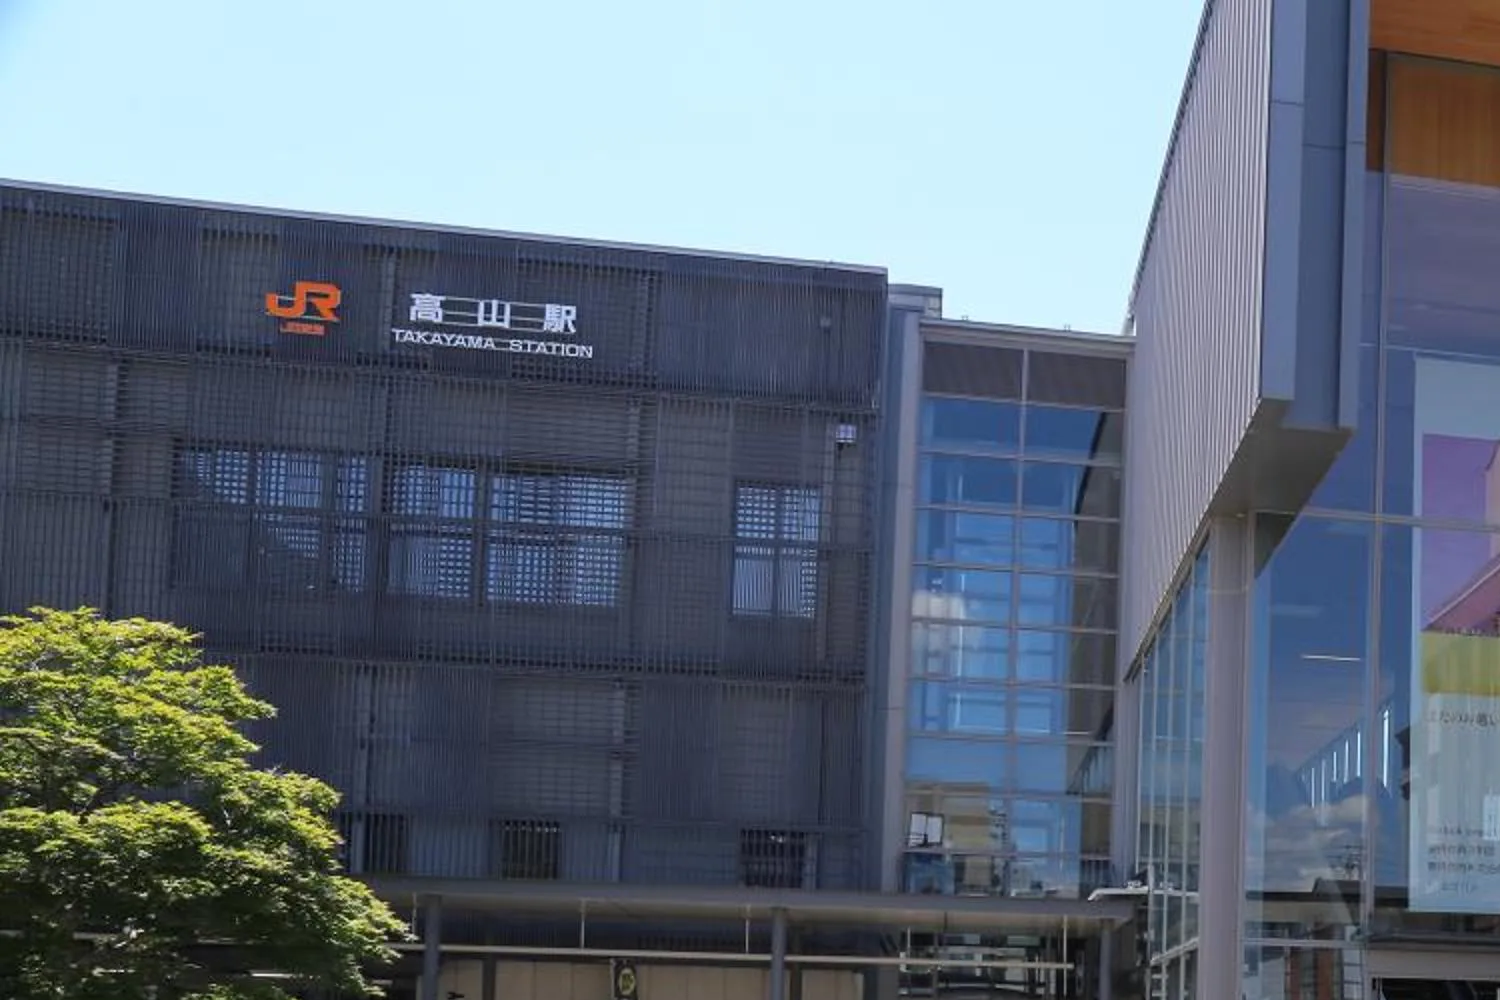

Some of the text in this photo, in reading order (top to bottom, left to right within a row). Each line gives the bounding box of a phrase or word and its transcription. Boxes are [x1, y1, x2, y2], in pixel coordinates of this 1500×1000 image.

[265, 282, 341, 320] JR
[410, 293, 577, 334] 高山駅
[391, 328, 593, 358] TAKAYAMA STATION
